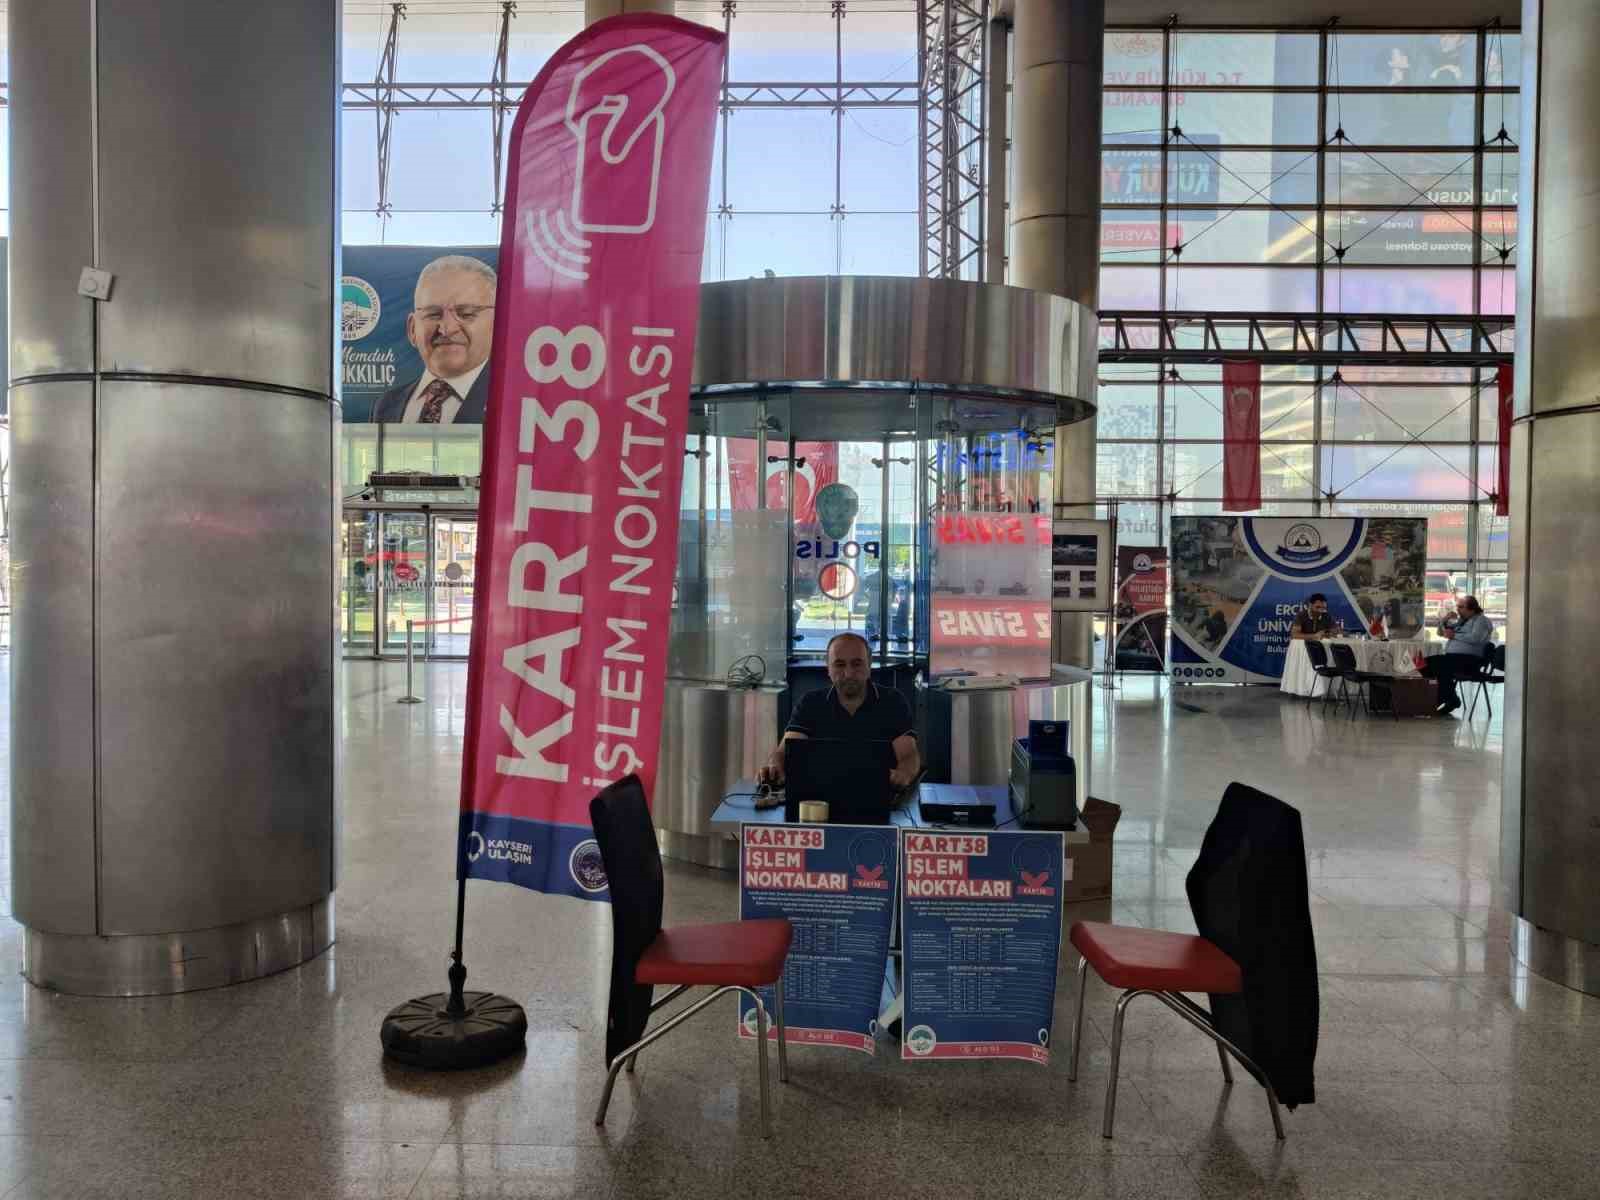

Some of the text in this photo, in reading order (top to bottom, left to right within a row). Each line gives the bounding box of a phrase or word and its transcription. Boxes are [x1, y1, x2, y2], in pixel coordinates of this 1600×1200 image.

[608, 324, 675, 596] NOKTASI
[494, 324, 608, 784] KART38
[745, 828, 823, 848] KART38
[906, 835, 987, 855] KART38
[745, 847, 801, 869] İŞLEM
[906, 856, 965, 878] İŞLEM
[745, 870, 847, 890] NOKTALARI
[906, 879, 1012, 897] NOKTALARI
